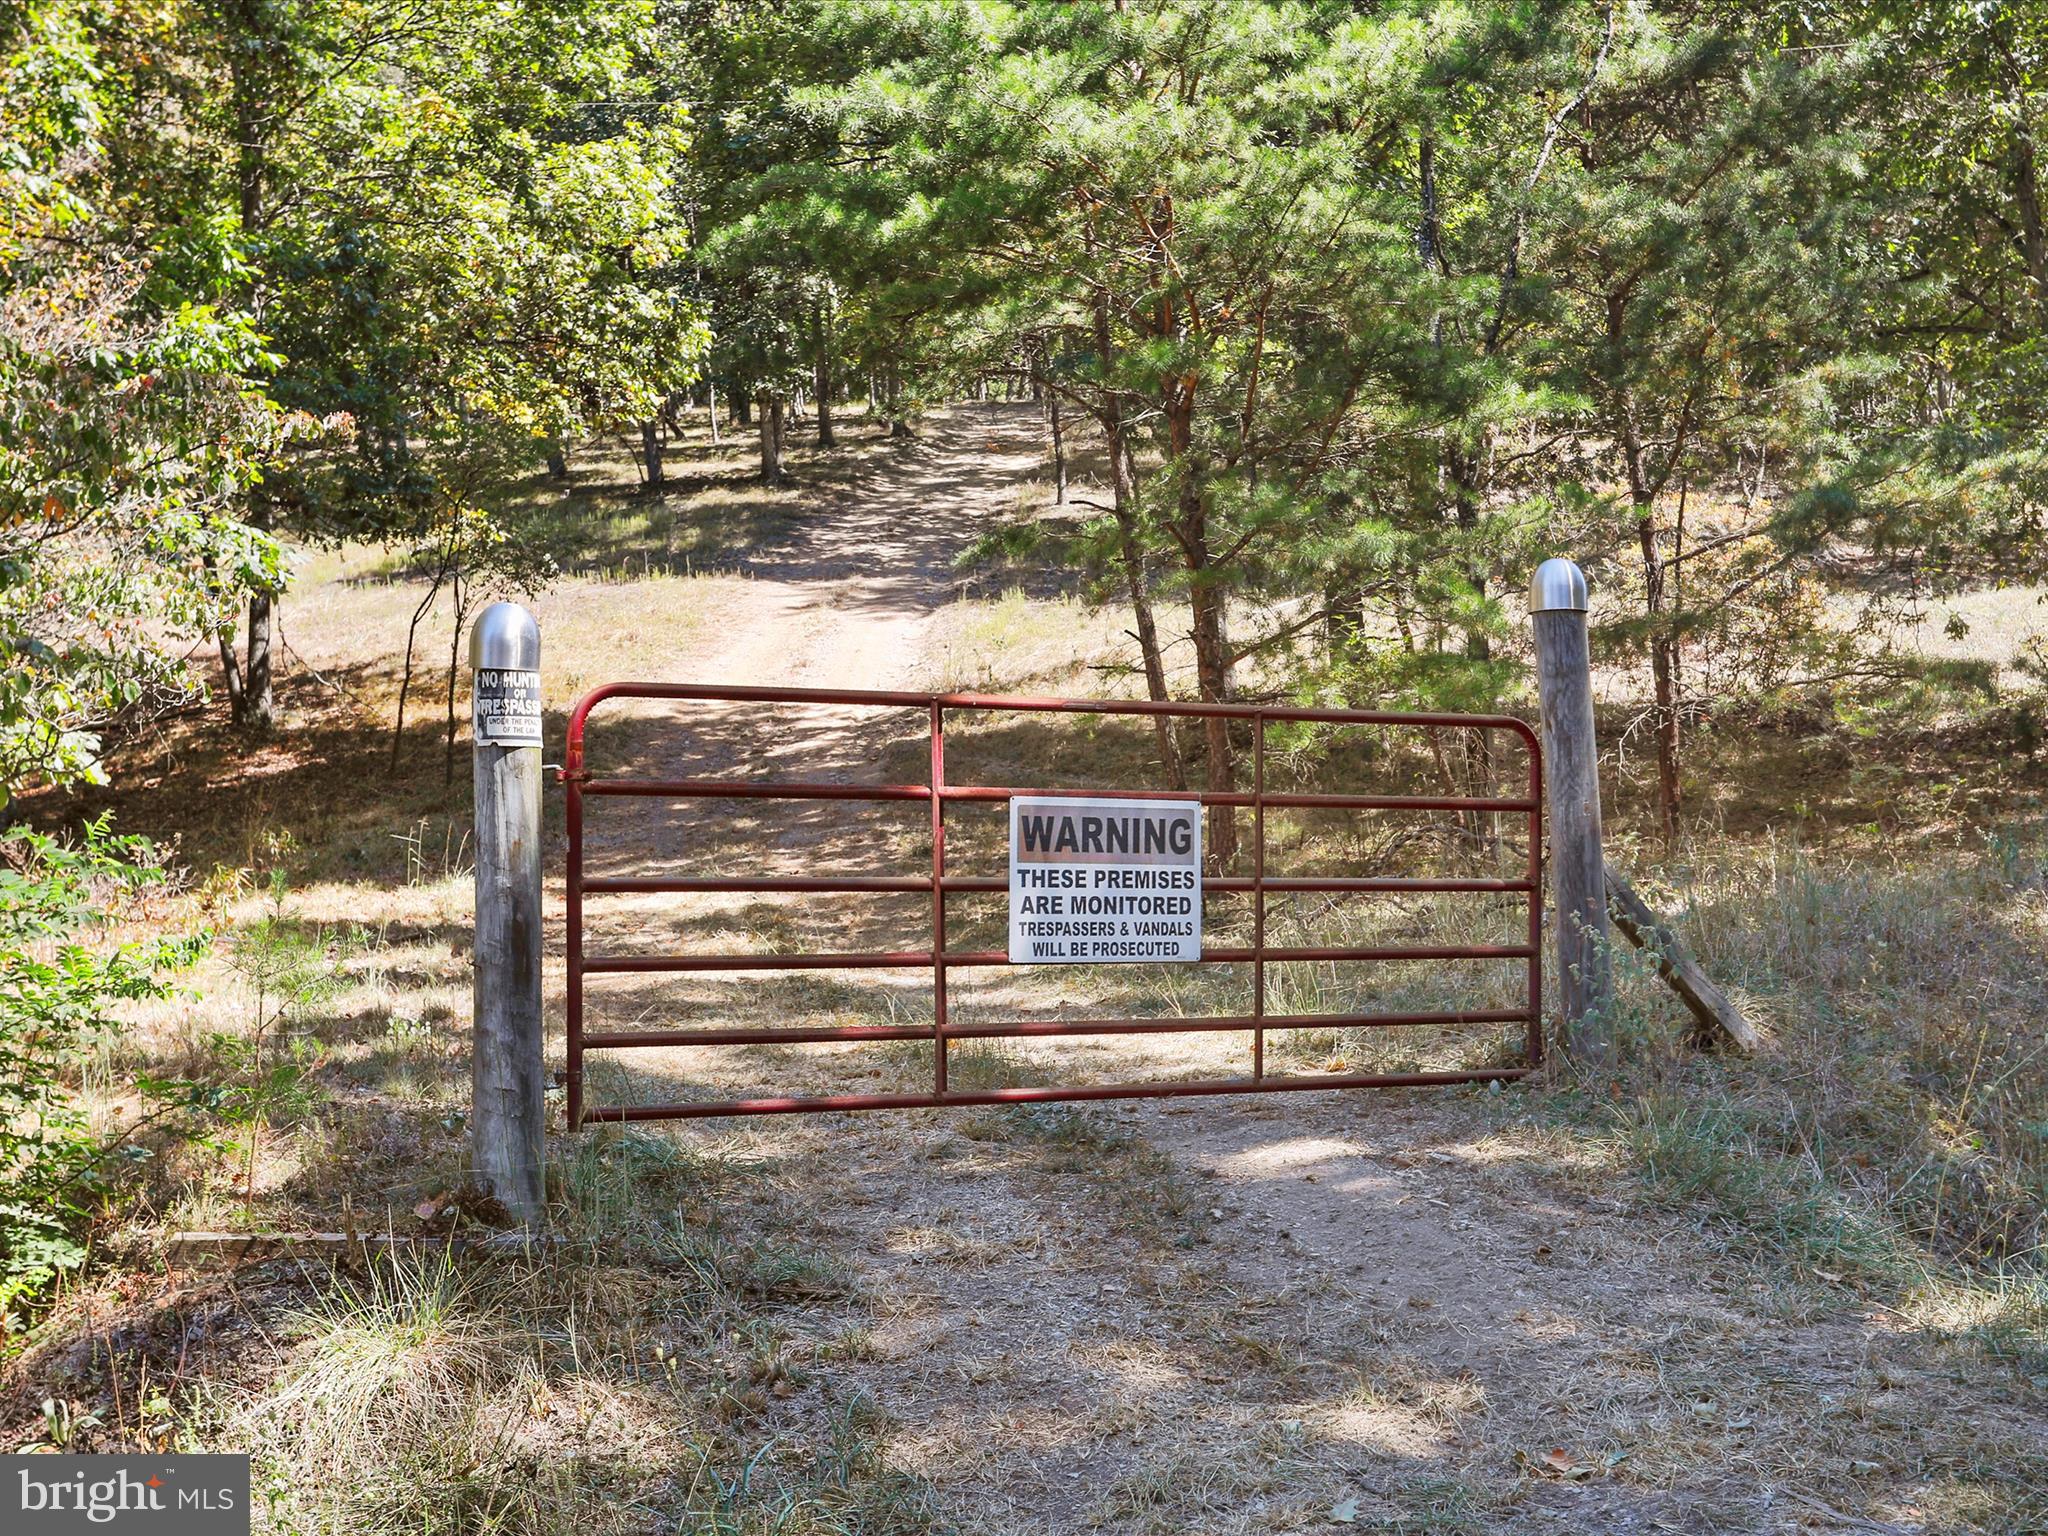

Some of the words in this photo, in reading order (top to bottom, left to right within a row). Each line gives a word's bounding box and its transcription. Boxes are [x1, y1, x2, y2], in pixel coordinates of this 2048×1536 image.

[481, 671, 498, 688] NO
[513, 688, 527, 699] OR
[488, 717, 510, 726] UNDER
[511, 718, 523, 726] THE
[1021, 815, 1192, 855] WARNING
[1017, 869, 1087, 888] THESE
[1094, 870, 1195, 889] PREMISES
[1020, 895, 1063, 915] ARE
[1070, 896, 1192, 915] MONITORED
[1019, 921, 1115, 937] TRESPASSERS
[1120, 921, 1129, 937] &
[1134, 922, 1193, 937] VANDALS
[1032, 942, 1066, 957] WILL
[1070, 942, 1088, 957] BE
[1092, 941, 1180, 957] PROSECUTED
